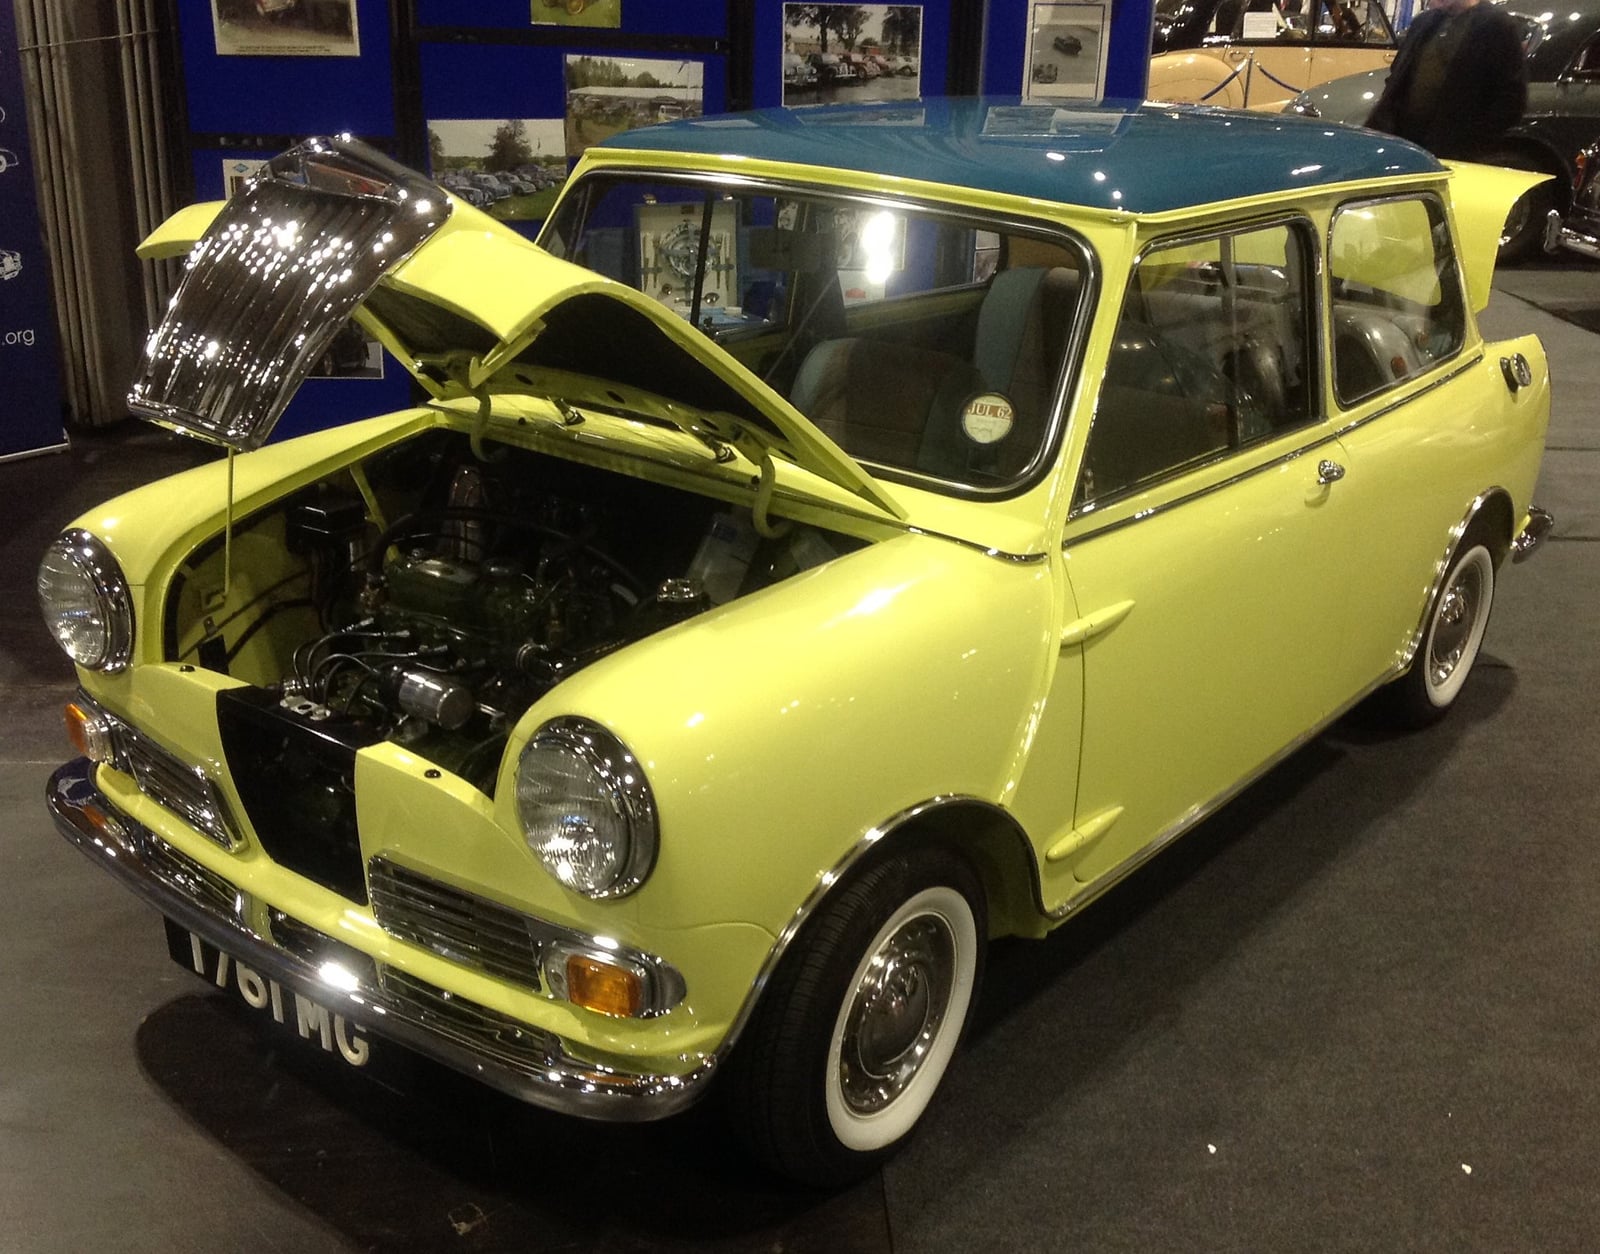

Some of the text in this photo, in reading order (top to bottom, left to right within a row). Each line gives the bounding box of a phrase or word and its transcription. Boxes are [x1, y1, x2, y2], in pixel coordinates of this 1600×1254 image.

[2, 329, 35, 346] .org
[967, 402, 1012, 420] JUL 62
[295, 993, 370, 1067] MG
